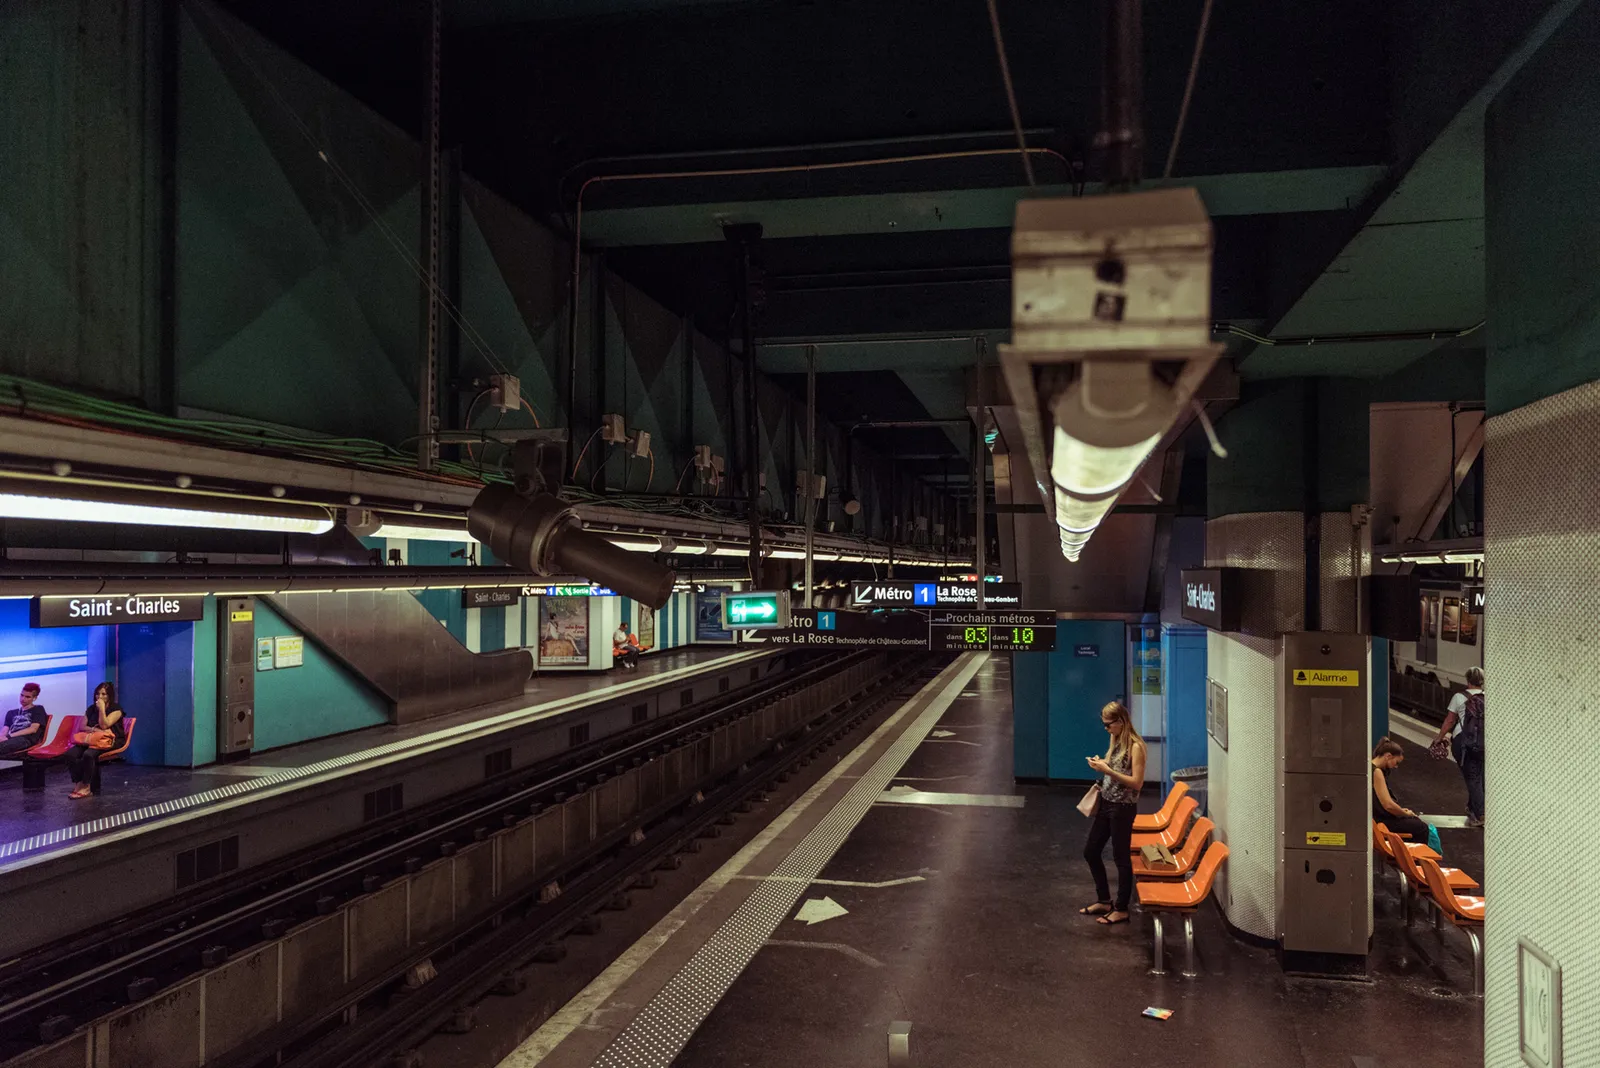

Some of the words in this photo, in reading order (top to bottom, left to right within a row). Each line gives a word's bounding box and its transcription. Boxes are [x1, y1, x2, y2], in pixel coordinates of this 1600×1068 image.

[475, 592, 488, 603] Saint
[492, 592, 511, 602] Charles
[874, 587, 912, 600] Métro
[920, 587, 928, 602] 1
[936, 586, 950, 597] La
[951, 586, 977, 597] Rose
[69, 598, 113, 618] Saint
[125, 596, 180, 615] Charles
[822, 614, 830, 628] 1
[946, 613, 996, 623] Prochains
[999, 613, 1036, 623] métros
[793, 632, 805, 643] La
[808, 632, 834, 643] Rose
[835, 636, 868, 645] Technopôle
[965, 627, 987, 643] 03
[1012, 627, 1034, 644] 10
[1312, 672, 1347, 682] Alarme
